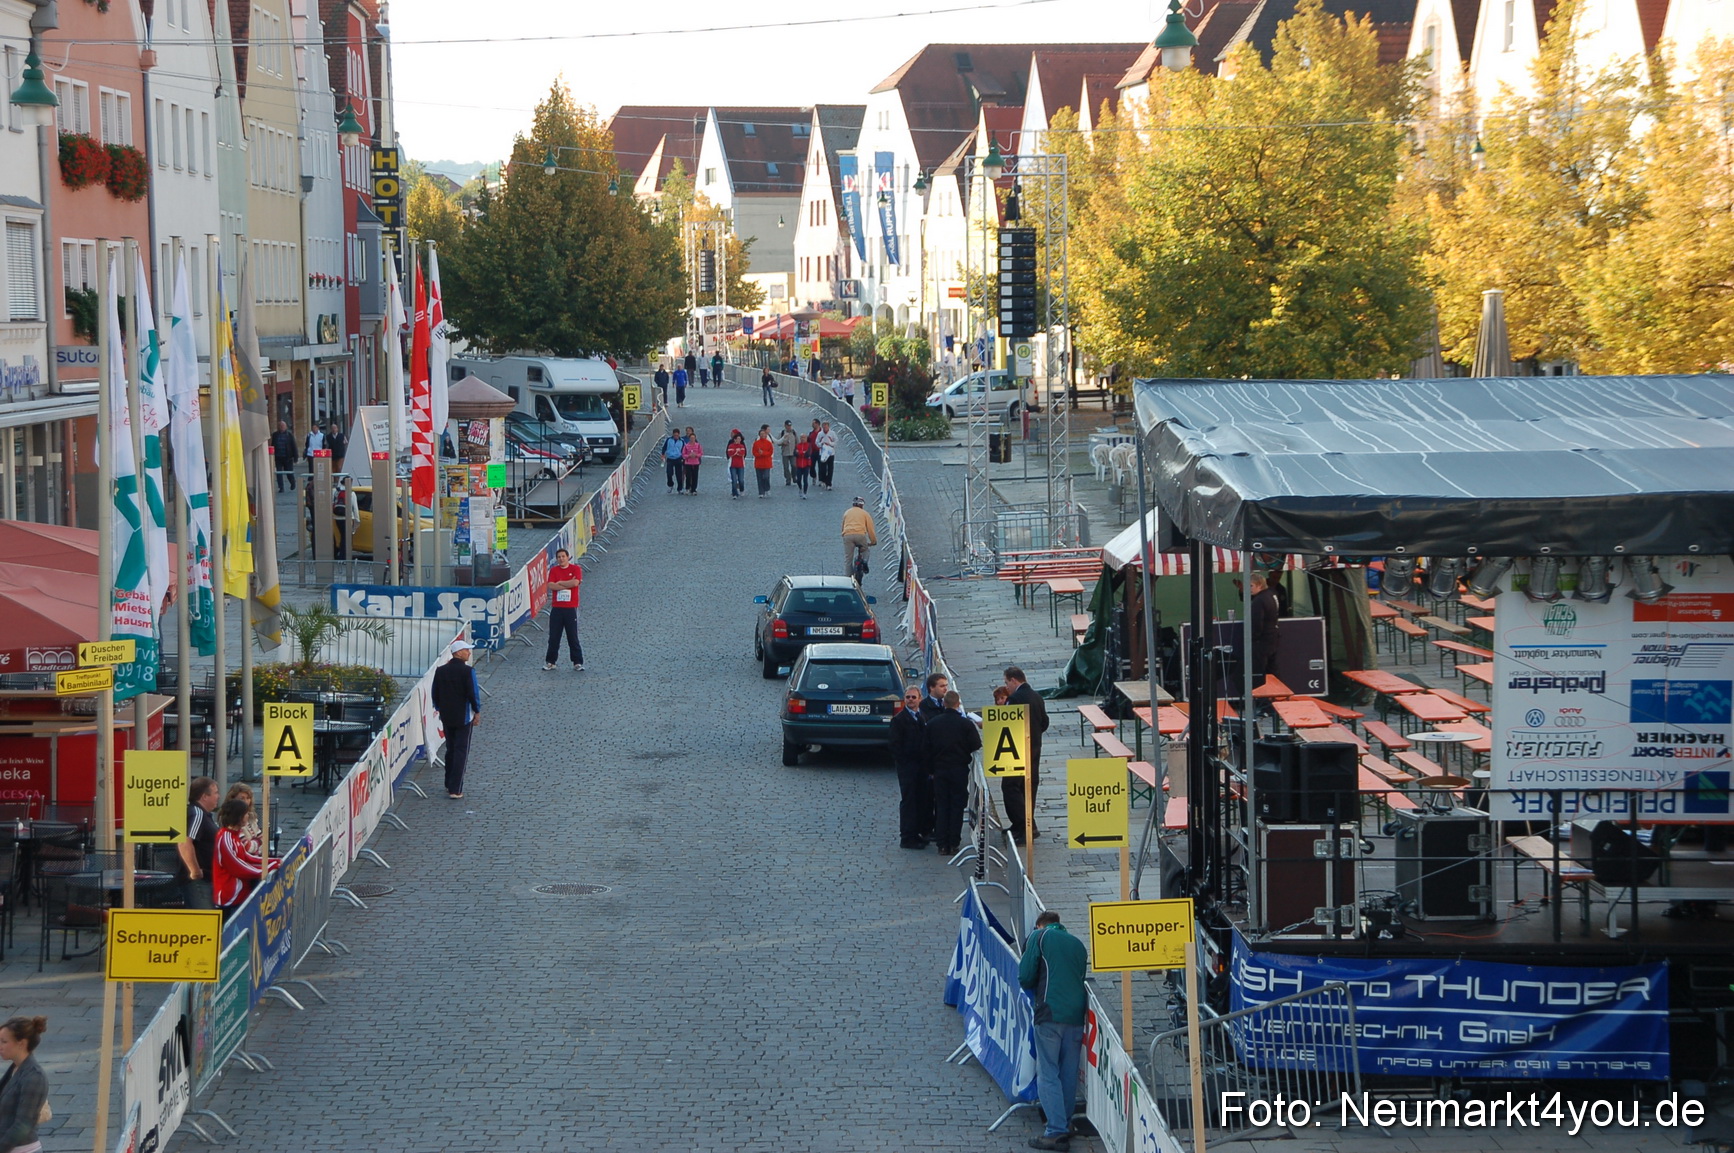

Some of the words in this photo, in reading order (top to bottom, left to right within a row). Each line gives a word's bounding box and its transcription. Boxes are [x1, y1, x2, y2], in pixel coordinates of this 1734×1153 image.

[627, 393, 636, 405] B
[875, 390, 885, 402] B
[337, 589, 425, 618] Karl
[91, 644, 126, 654] Duschen
[1514, 649, 1550, 660] Tagblatt
[1552, 649, 1602, 659] Neumarkter
[93, 653, 123, 662] Freibad
[66, 678, 109, 690] Bambinilauf
[270, 705, 307, 718] Block
[831, 704, 844, 713] LAU
[858, 704, 870, 713] 375
[987, 708, 1024, 722] Block
[273, 726, 302, 760] A
[993, 727, 1020, 761] A
[1637, 732, 1724, 744] HACKNER
[1506, 741, 1604, 759] FISCHER
[1631, 746, 1716, 758] INTERSPORT
[1507, 769, 1678, 783] AKTIENGESELLSCHAFT
[127, 775, 185, 793] Jugend-
[1069, 782, 1126, 800] Jugend-
[143, 792, 170, 807] lauf
[1085, 798, 1111, 813] lauf
[1096, 922, 1185, 939] Schnupper-
[116, 930, 212, 947] Schnupper-
[1127, 938, 1156, 953] lauf
[148, 946, 183, 964] lauf
[1404, 974, 1650, 1005] THUNDER
